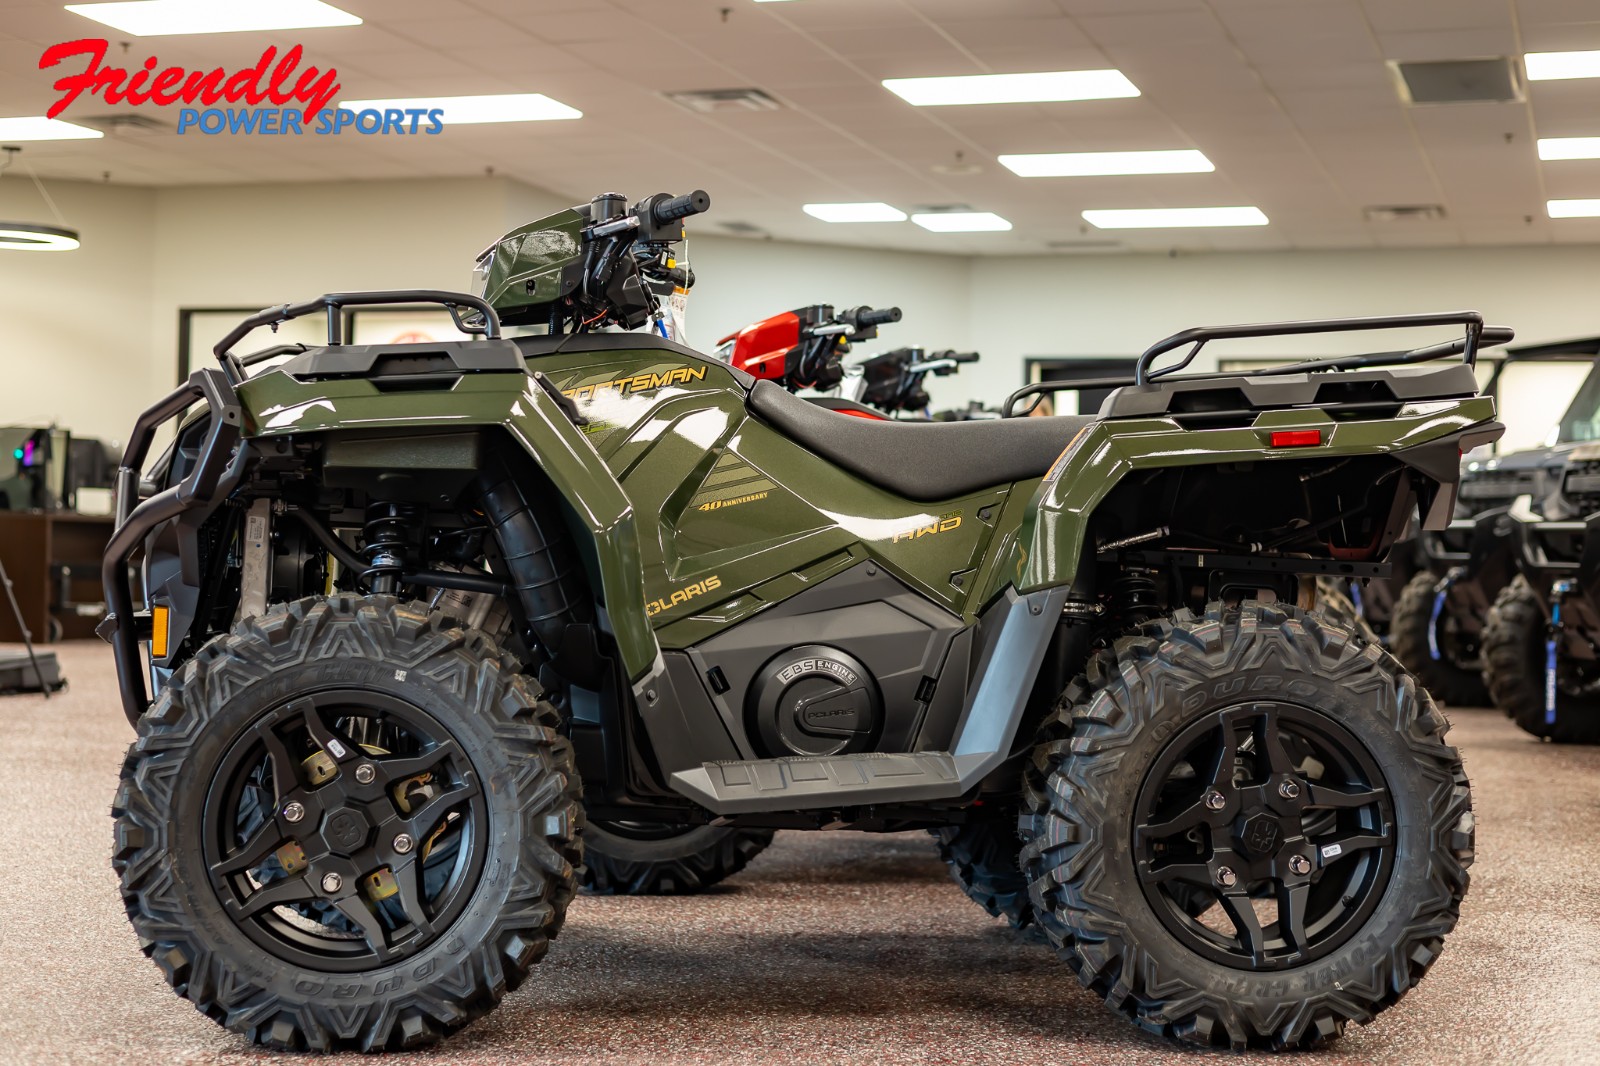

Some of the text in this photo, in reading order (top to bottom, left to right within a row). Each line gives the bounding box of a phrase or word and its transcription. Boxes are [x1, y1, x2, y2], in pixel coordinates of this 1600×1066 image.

[699, 492, 768, 511] 40 ANNIVERSARY
[644, 575, 721, 616] OLARIS
[781, 660, 814, 681] EBS
[816, 660, 856, 681] ENGINE
[1181, 675, 1319, 718] DURO
[808, 708, 855, 719] POLARIS
